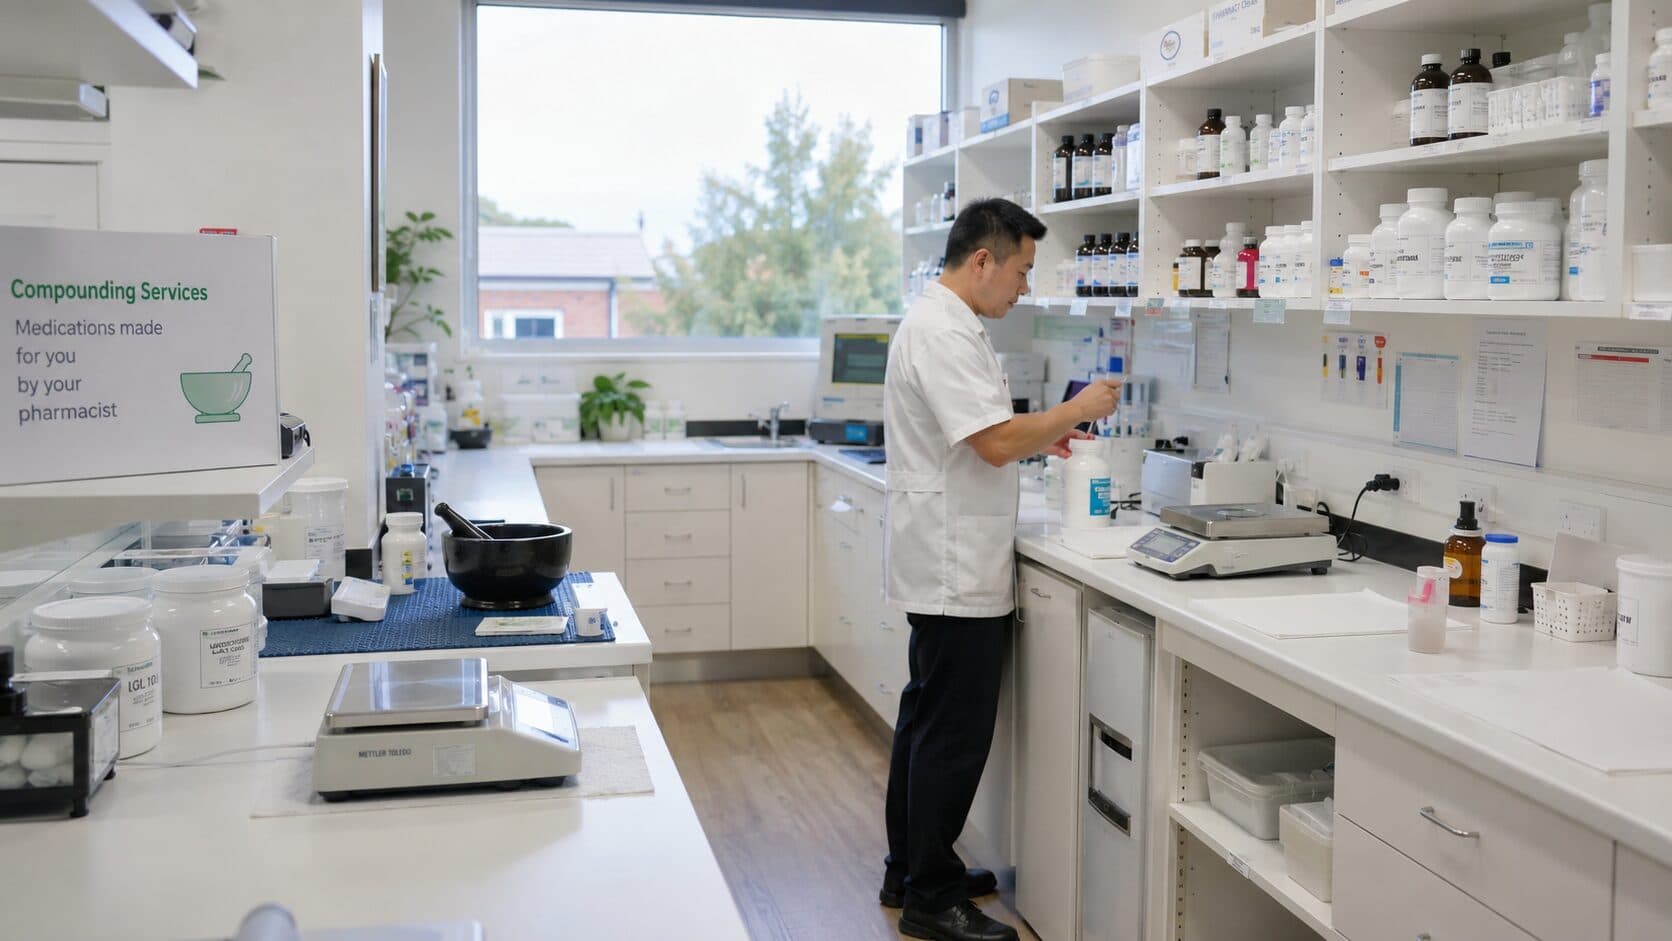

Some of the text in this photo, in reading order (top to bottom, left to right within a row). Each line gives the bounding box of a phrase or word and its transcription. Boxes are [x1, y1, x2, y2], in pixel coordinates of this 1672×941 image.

[11, 279, 208, 304] Compounding Services
[15, 319, 163, 336] Medications made
[16, 346, 76, 367] for you
[18, 376, 82, 397] by your
[19, 402, 118, 426] pharmacist
[358, 749, 386, 758] METTLER
